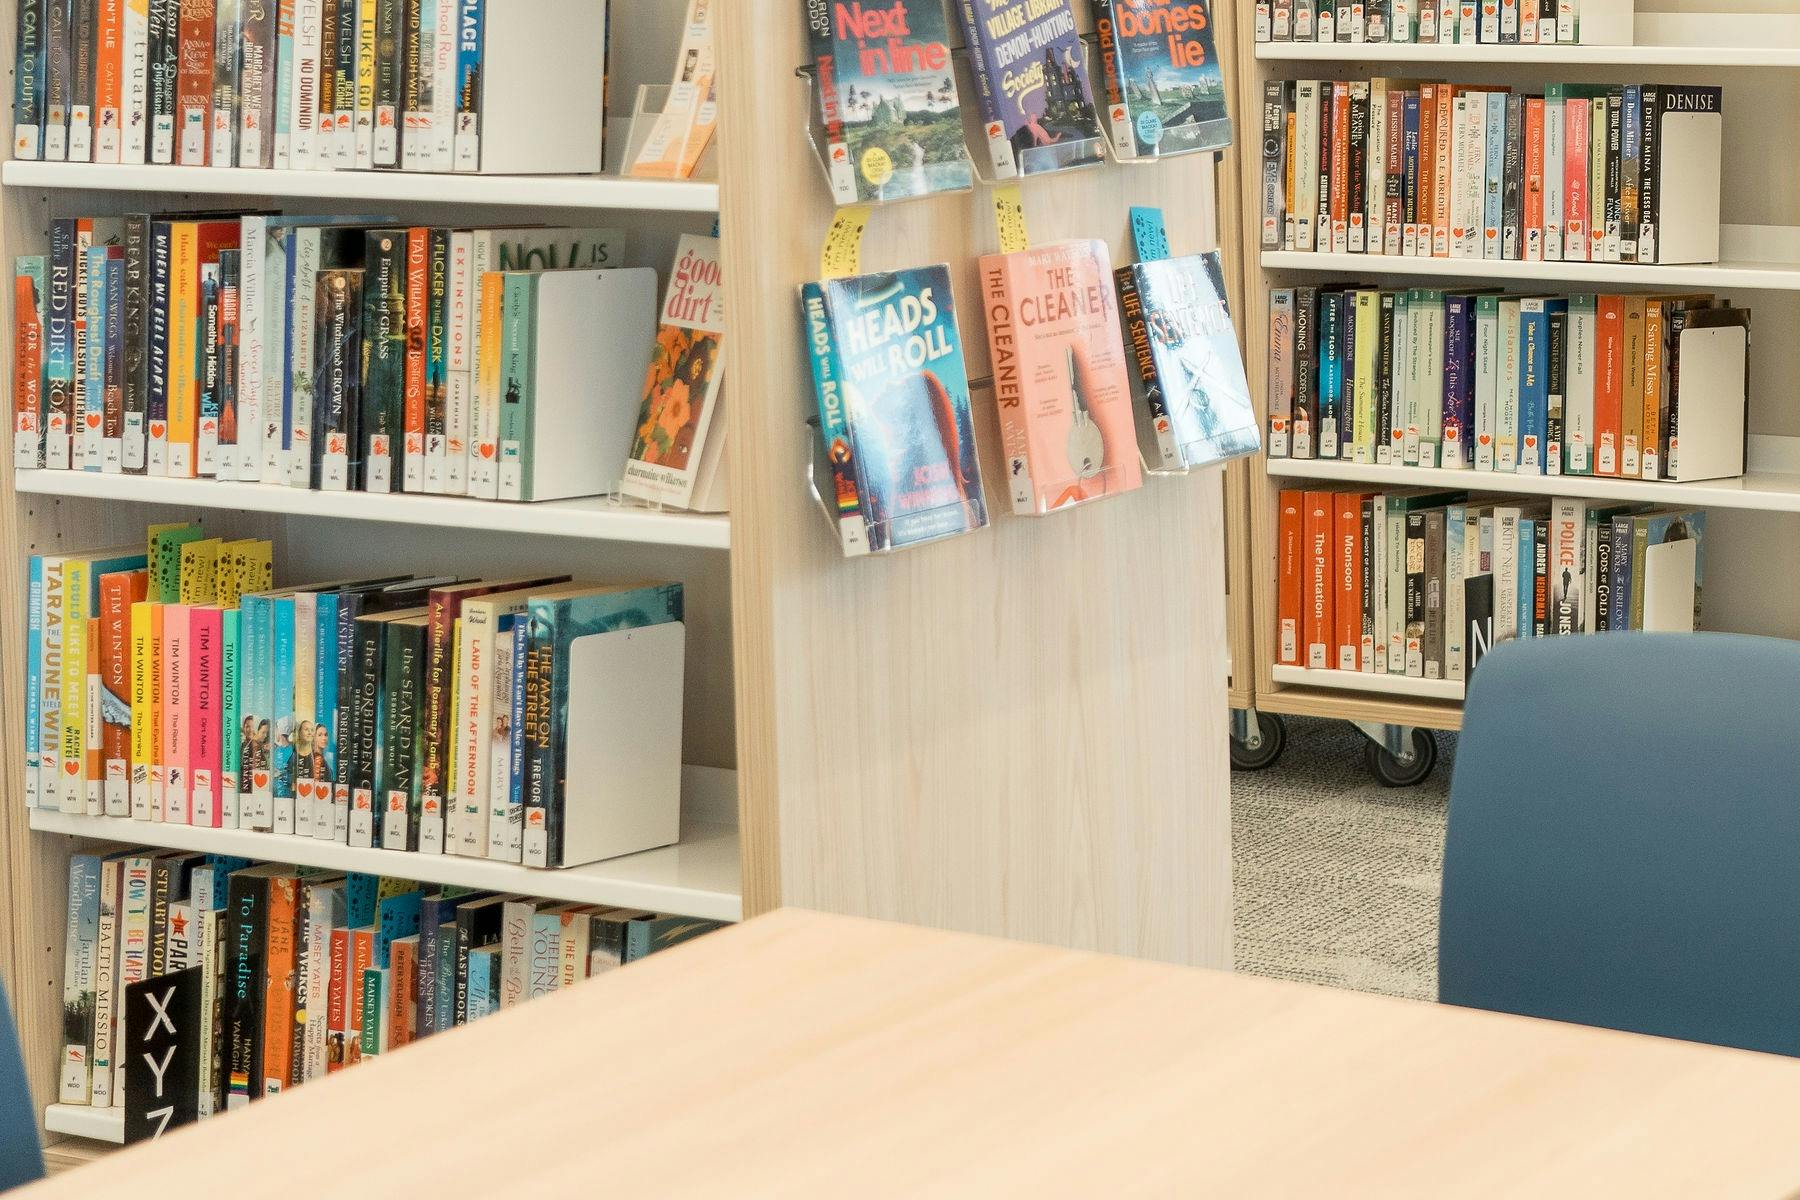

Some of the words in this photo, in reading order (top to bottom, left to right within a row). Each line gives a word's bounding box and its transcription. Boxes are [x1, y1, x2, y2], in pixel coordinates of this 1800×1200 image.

[105, 25, 115, 49] LIE
[833, 0, 911, 41] Next
[985, 3, 1024, 40] VILLAGE
[993, 9, 1075, 69] DEMON-HUNTING
[1116, 3, 1207, 39] bones
[361, 18, 375, 78] LUKE'S
[857, 38, 890, 78] in
[886, 37, 946, 75] line
[1168, 33, 1206, 69] lie
[1001, 60, 1045, 106] Society
[1663, 92, 1714, 111] DENISE
[51, 263, 70, 313] RED
[432, 243, 445, 297] FLICKER
[988, 267, 1005, 300] THE
[1046, 266, 1075, 288] THE
[453, 246, 466, 368] EXTINCTIONS
[667, 285, 713, 323] dirt
[806, 296, 831, 355] HEADS
[845, 287, 938, 355] HEADS
[1019, 284, 1113, 327] CLEANER
[1122, 291, 1142, 319] LIFE
[50, 316, 68, 371] DIRT
[207, 303, 219, 355] Something
[430, 324, 443, 364] DARK
[1129, 319, 1158, 381] SENTENCE
[205, 355, 217, 389] Hidden
[820, 357, 833, 378] WILL
[990, 303, 1018, 410] CLEANER
[821, 380, 842, 429] ROLL
[1312, 531, 1323, 554] The
[1342, 534, 1353, 592] Monsoon
[109, 584, 122, 614] TIM
[1312, 554, 1323, 620] Plantation
[112, 617, 124, 686] WINTON
[152, 637, 161, 659] TIM
[526, 650, 540, 676] THE
[1468, 615, 1492, 670] N
[151, 660, 161, 706] WINTON
[524, 682, 539, 741] STREET
[532, 756, 542, 805] TREVOR
[152, 867, 169, 915] STUART
[239, 894, 253, 915] To
[235, 917, 252, 1000] Paradise
[143, 986, 178, 1042] X
[142, 1045, 178, 1098] Y
